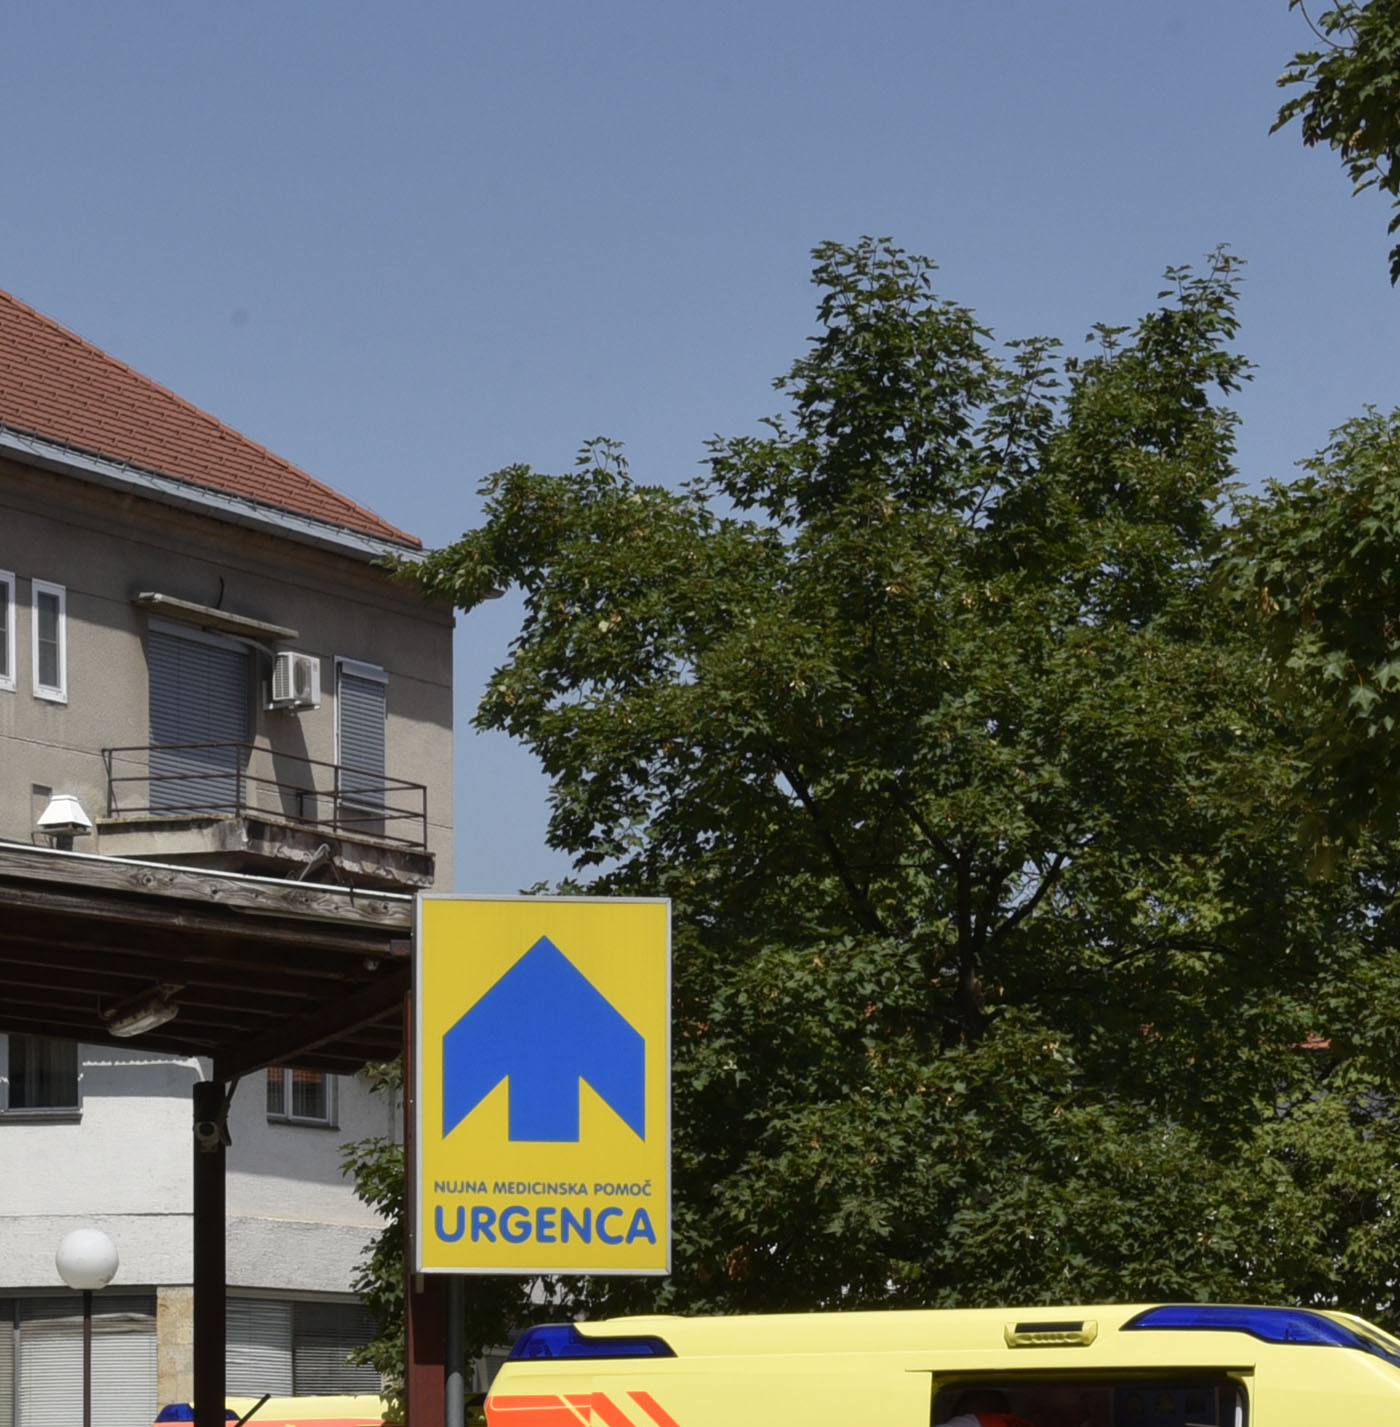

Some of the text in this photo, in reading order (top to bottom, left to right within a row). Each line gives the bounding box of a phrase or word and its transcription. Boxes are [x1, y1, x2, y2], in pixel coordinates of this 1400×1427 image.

[433, 1178, 652, 1197] NUJNA MEDICINSKA POMOČ
[434, 1204, 657, 1246] URGENCA
